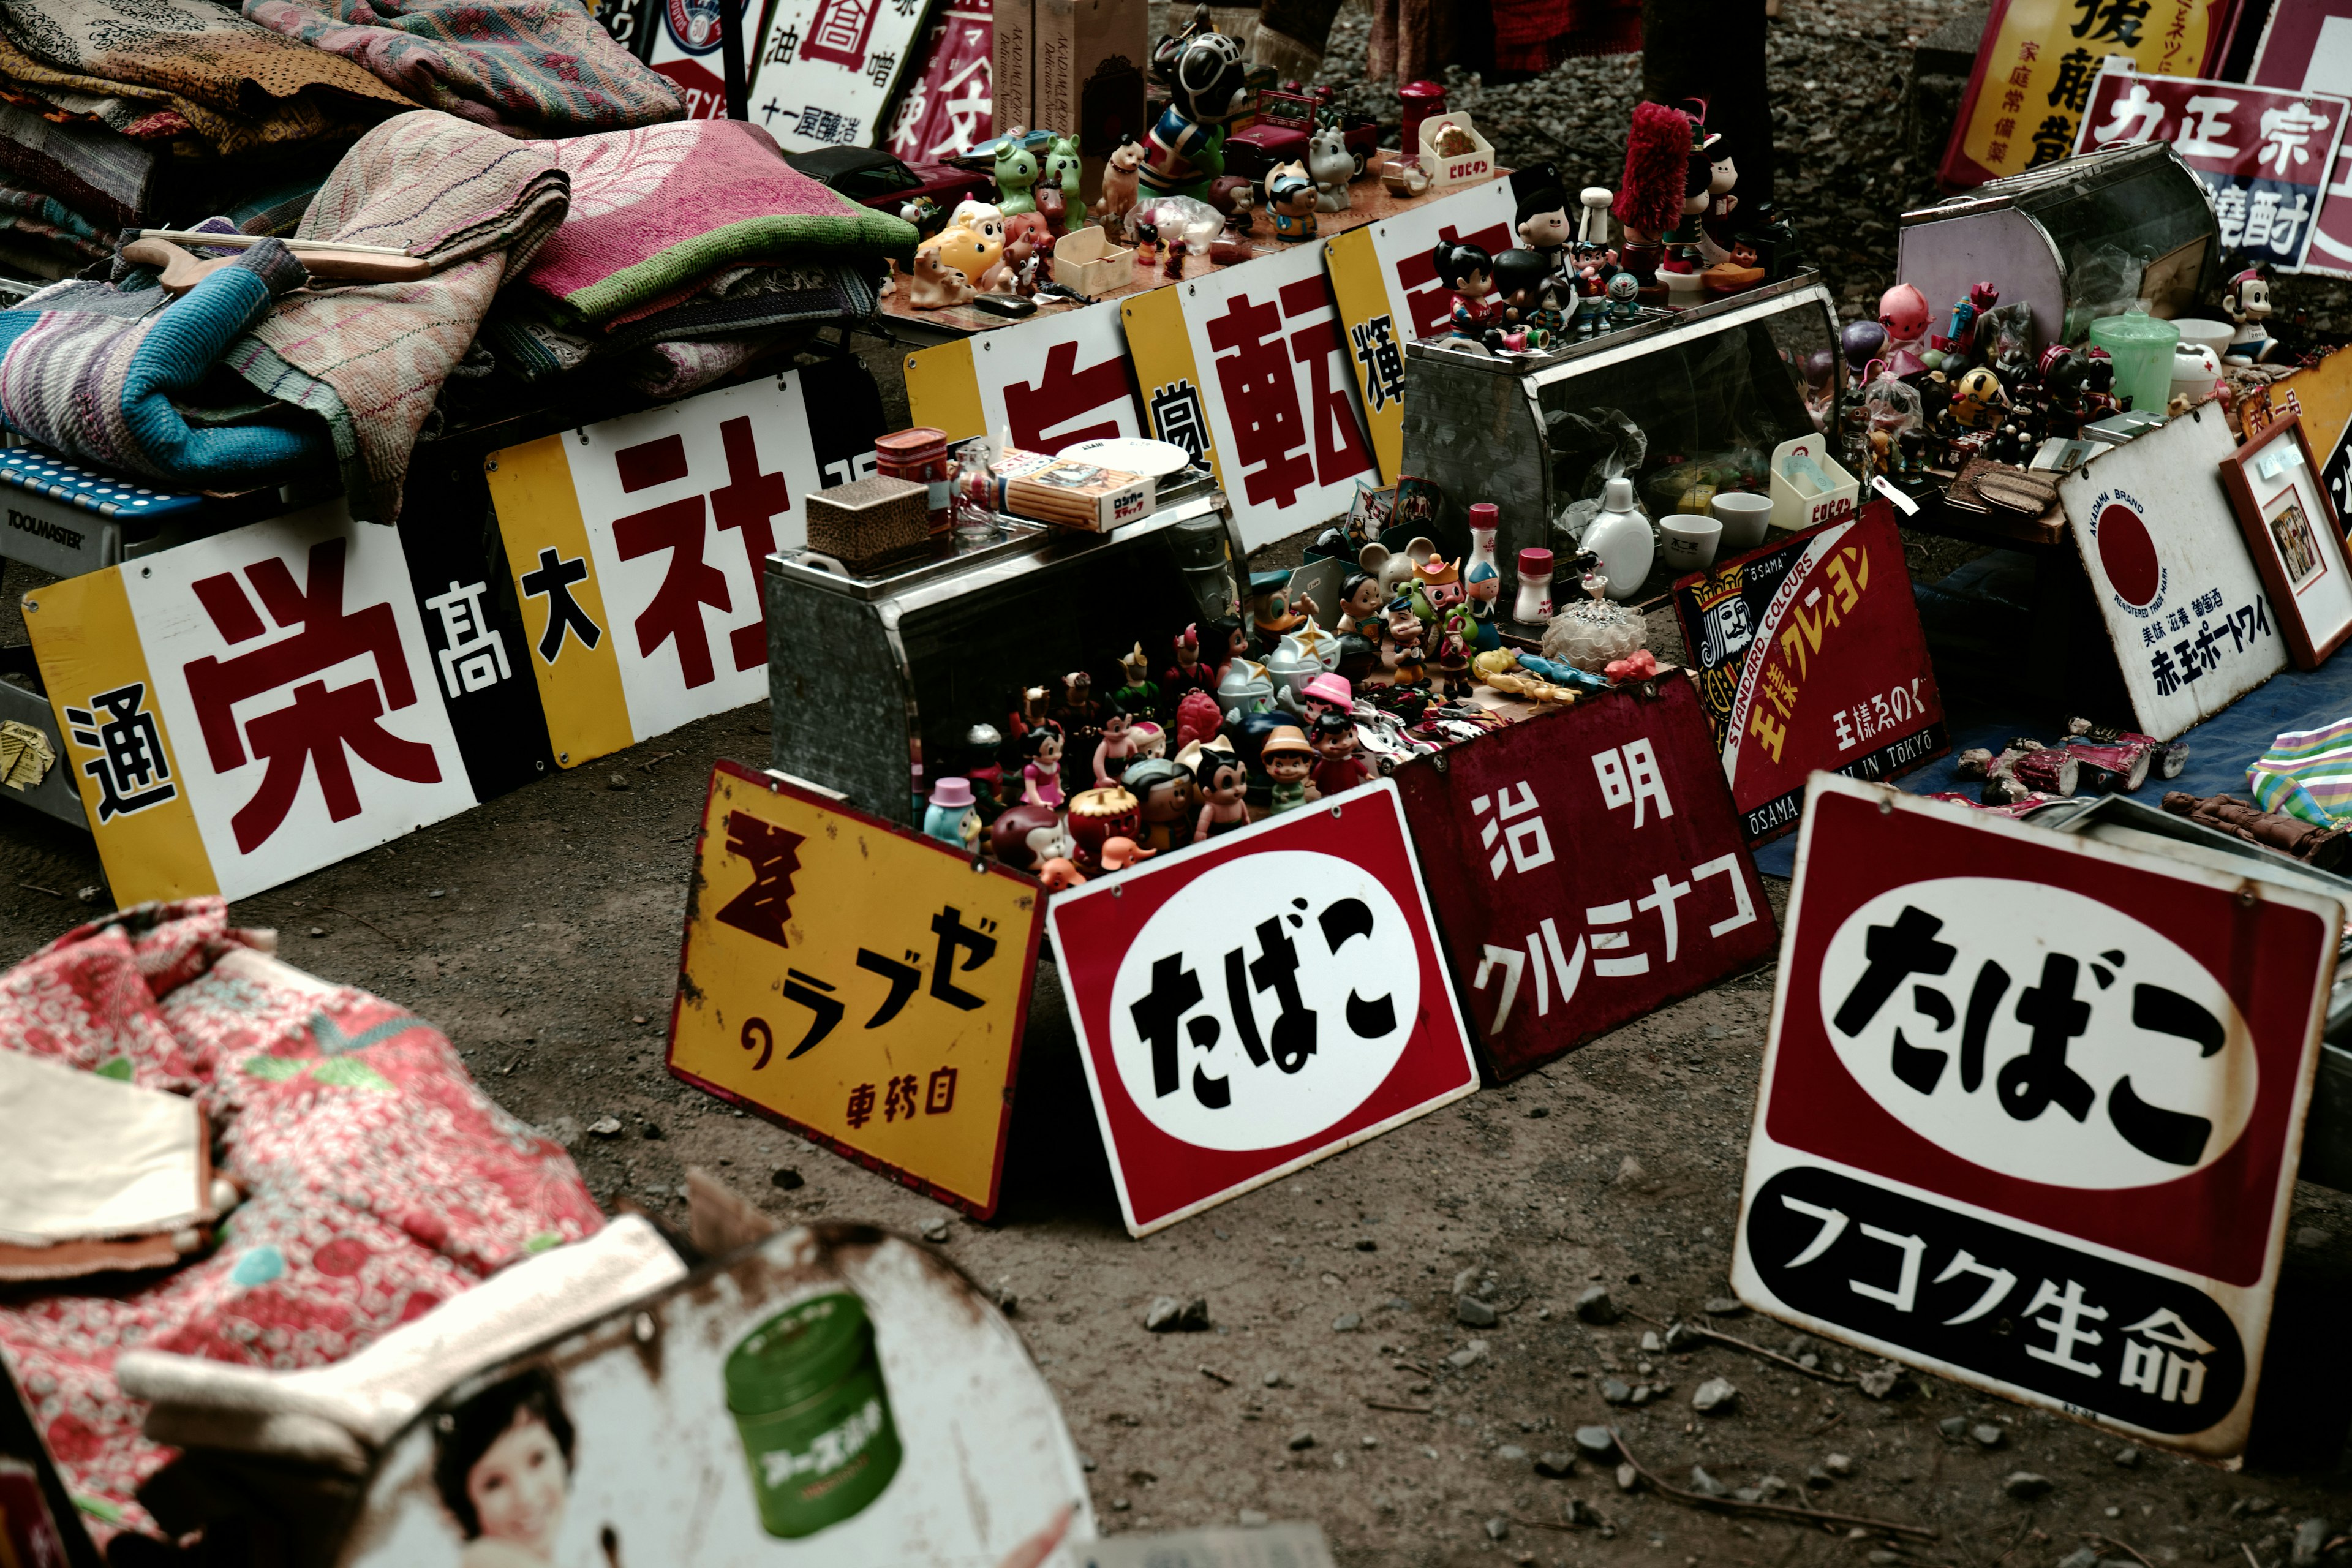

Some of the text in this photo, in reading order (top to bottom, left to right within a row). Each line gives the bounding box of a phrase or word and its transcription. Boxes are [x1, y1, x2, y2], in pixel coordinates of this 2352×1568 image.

[2094, 85, 2330, 175] 力正宗
[7, 508, 82, 551] TOOLMASTER
[612, 415, 791, 690] 社
[2090, 489, 2144, 538] AKADAMA BRAND
[520, 545, 603, 666] 大
[1728, 552, 1813, 748] STANDARD COLOURS
[2114, 594, 2149, 618] REGISTERED
[2149, 593, 2164, 615] TRADE
[2141, 587, 2223, 648] 美味 滋養 葡萄酒
[64, 682, 178, 826] 通
[183, 537, 443, 856] 栄
[1129, 896, 1398, 1110] たばこ
[1833, 904, 2226, 1167] たばこ
[1779, 1193, 2217, 1405] フコク生命
